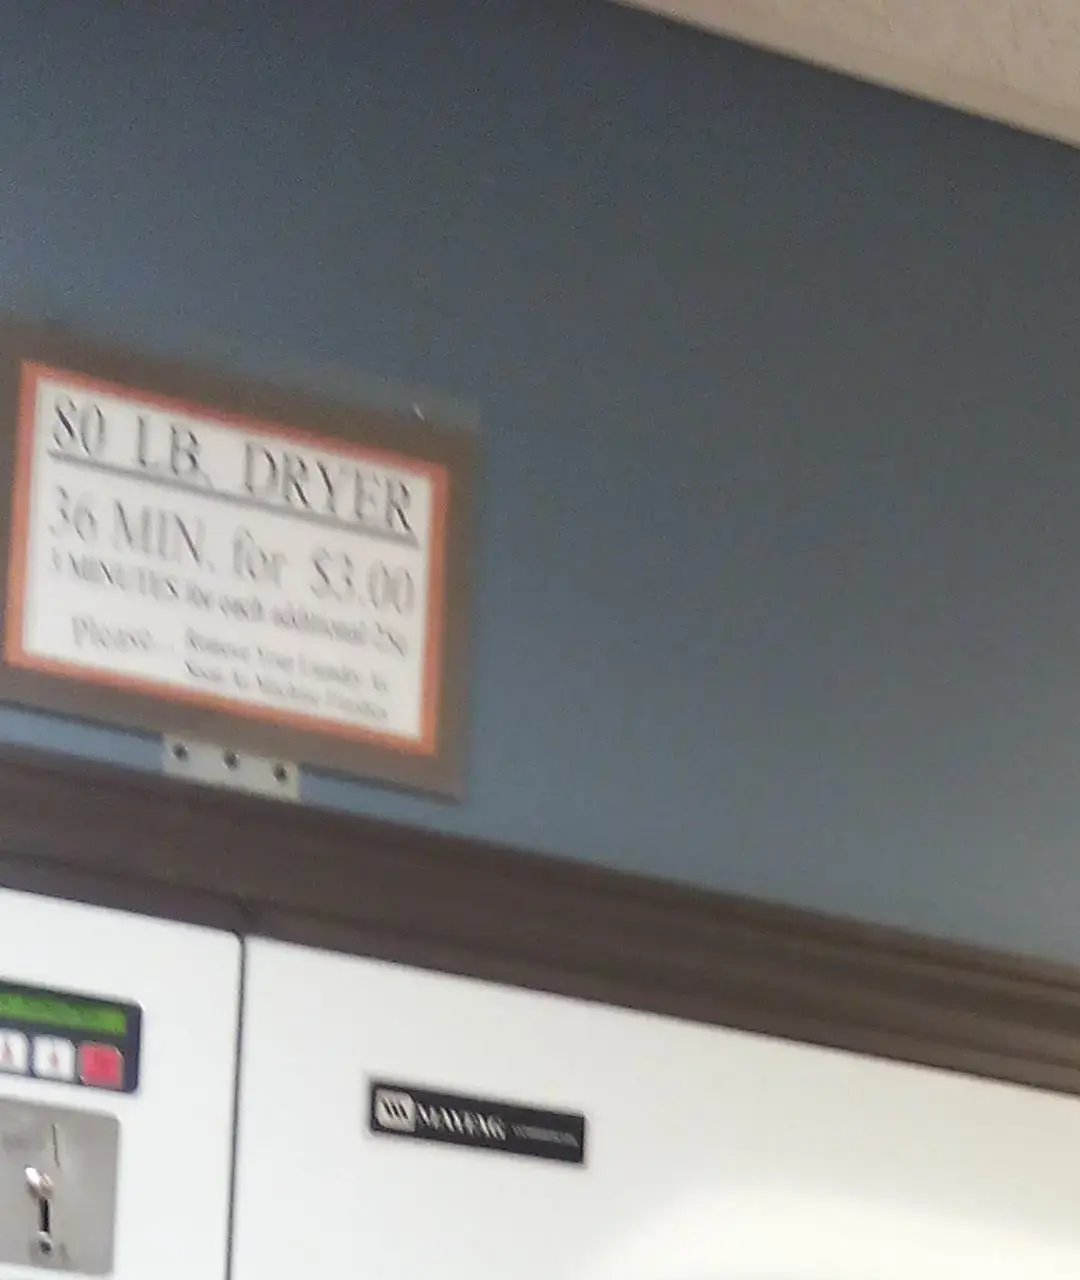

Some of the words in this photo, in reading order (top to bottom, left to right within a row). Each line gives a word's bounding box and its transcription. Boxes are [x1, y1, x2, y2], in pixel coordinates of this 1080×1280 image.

[244, 441, 412, 532] DRYER
[233, 524, 287, 588] for
[308, 546, 414, 616] $3.00
